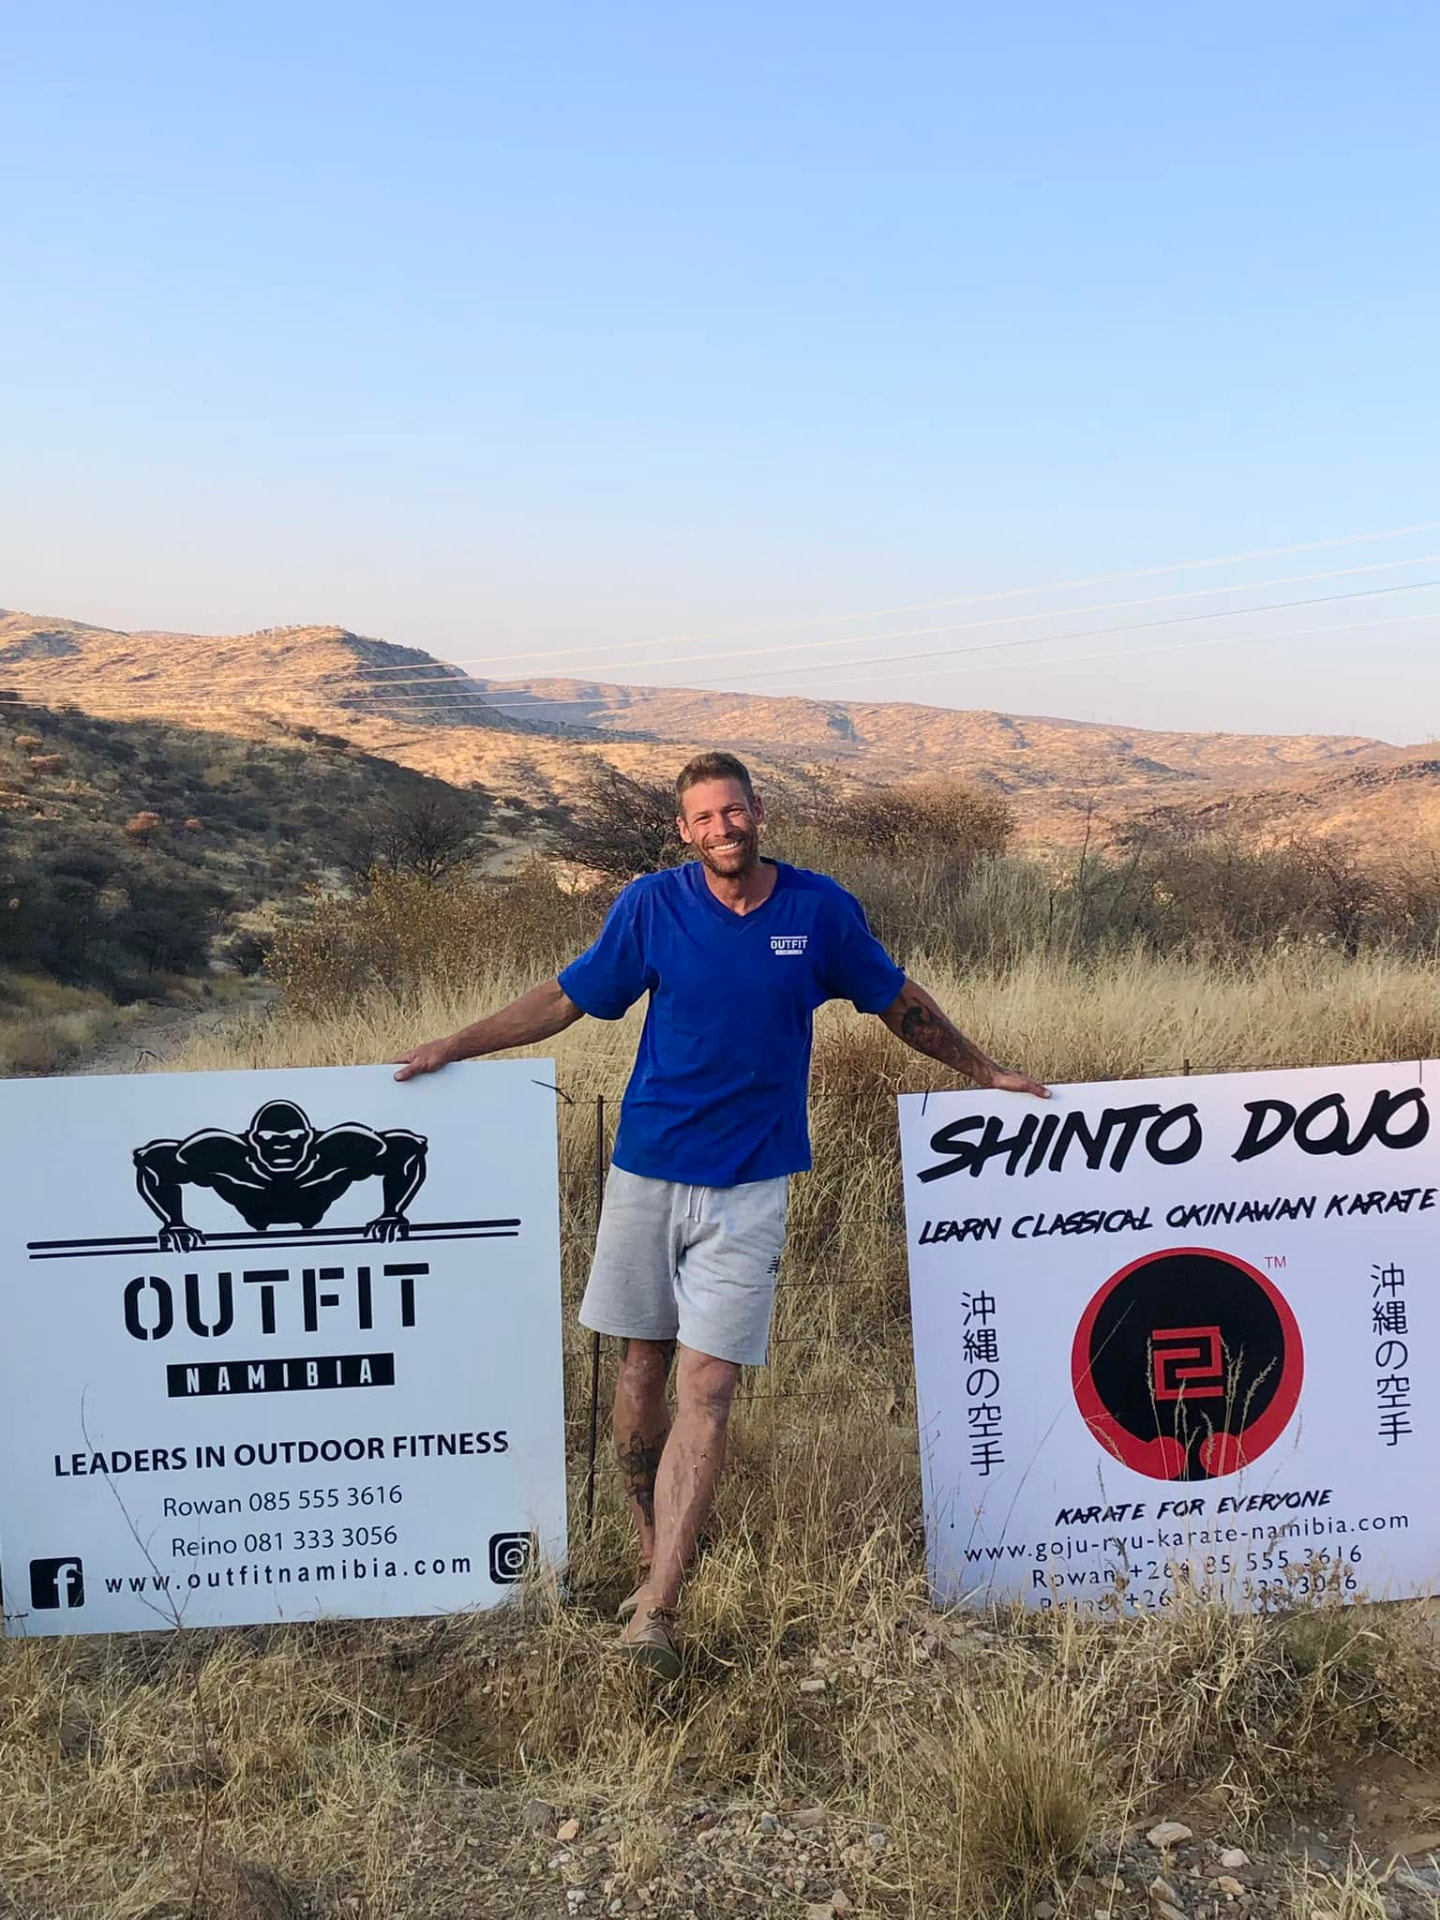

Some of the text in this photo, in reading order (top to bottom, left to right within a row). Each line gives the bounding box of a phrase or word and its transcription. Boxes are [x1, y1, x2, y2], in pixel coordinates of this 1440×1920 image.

[770, 940, 808, 949] OUTFIT
[917, 1088, 1431, 1184] SHINTO DOJO
[918, 1188, 1439, 1245] LEARN CLASSICAL OKINAWAN KARATE
[1264, 1256, 1287, 1269] TM
[123, 1262, 430, 1341] OUTFIT
[186, 1358, 373, 1394] NAMIBIA
[1371, 1263, 1413, 1447] 沖縄の空手
[961, 1290, 1005, 1476] 沖縄の空手
[54, 1430, 509, 1477] LEADERS IN OUTDOOR FITNESS
[163, 1484, 403, 1518] Rowan 085 555 3616
[1055, 1489, 1333, 1527] KARATE FOR EVERYONE
[172, 1525, 398, 1558] Reino 081 333 3056
[964, 1514, 1409, 1563] www.goju-ryu-karate-namibia.com
[105, 1555, 471, 1594] www.outfitnamibia.com
[1032, 1567, 1116, 1589] Rowan
[1246, 1550, 1289, 1572] 555
[1303, 1544, 1362, 1568] 3616
[1299, 1572, 1357, 1595] 306
